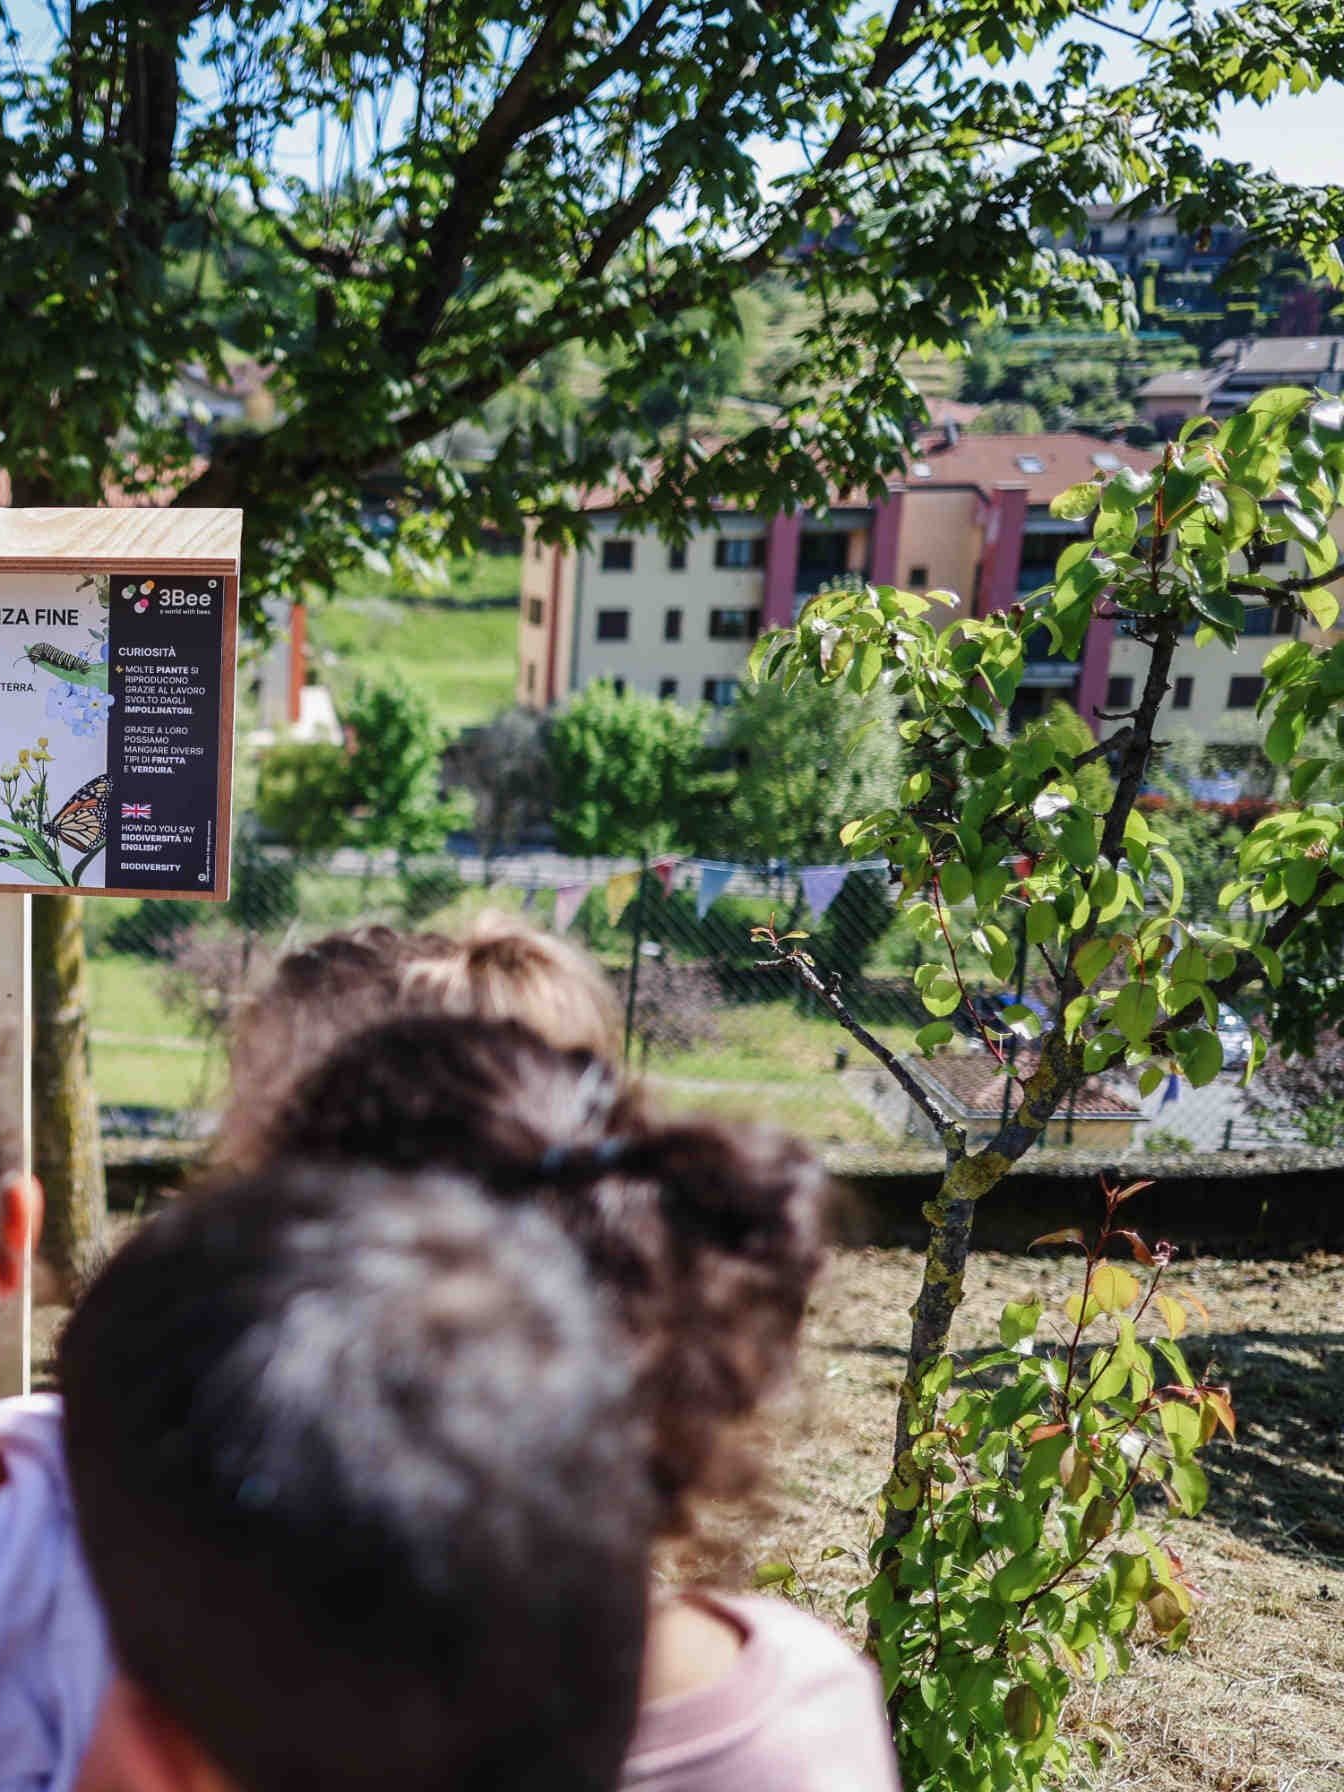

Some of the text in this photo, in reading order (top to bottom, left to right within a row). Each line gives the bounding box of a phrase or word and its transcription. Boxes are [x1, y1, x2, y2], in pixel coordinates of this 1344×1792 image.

[159, 588, 212, 606] 3Bee
[35, 609, 79, 626] FINE
[118, 645, 176, 657] CURIOSITÀ
[125, 666, 154, 674] MOLTE
[156, 666, 188, 674] PIANTE
[125, 676, 189, 684] RIPRODUCONO
[0, 682, 37, 692] TERRA.
[125, 686, 156, 694] GRAZIE
[170, 687, 206, 695] LAVORO
[125, 696, 186, 705] SVOLTO DAGLI
[124, 726, 188, 735] GRAZIE A LORO
[124, 736, 169, 744] POSSIAMO
[124, 746, 204, 755] MANGIARE DIVERSI
[124, 756, 186, 765] TIPI DI FRUTTA
[121, 824, 142, 832] HOW
[160, 825, 176, 833] YOU
[179, 826, 195, 834] SAY
[121, 834, 181, 843] BIODIVERSITÀ
[121, 843, 163, 852] ENGLISH?
[121, 863, 182, 871] BIODIVERSITY
